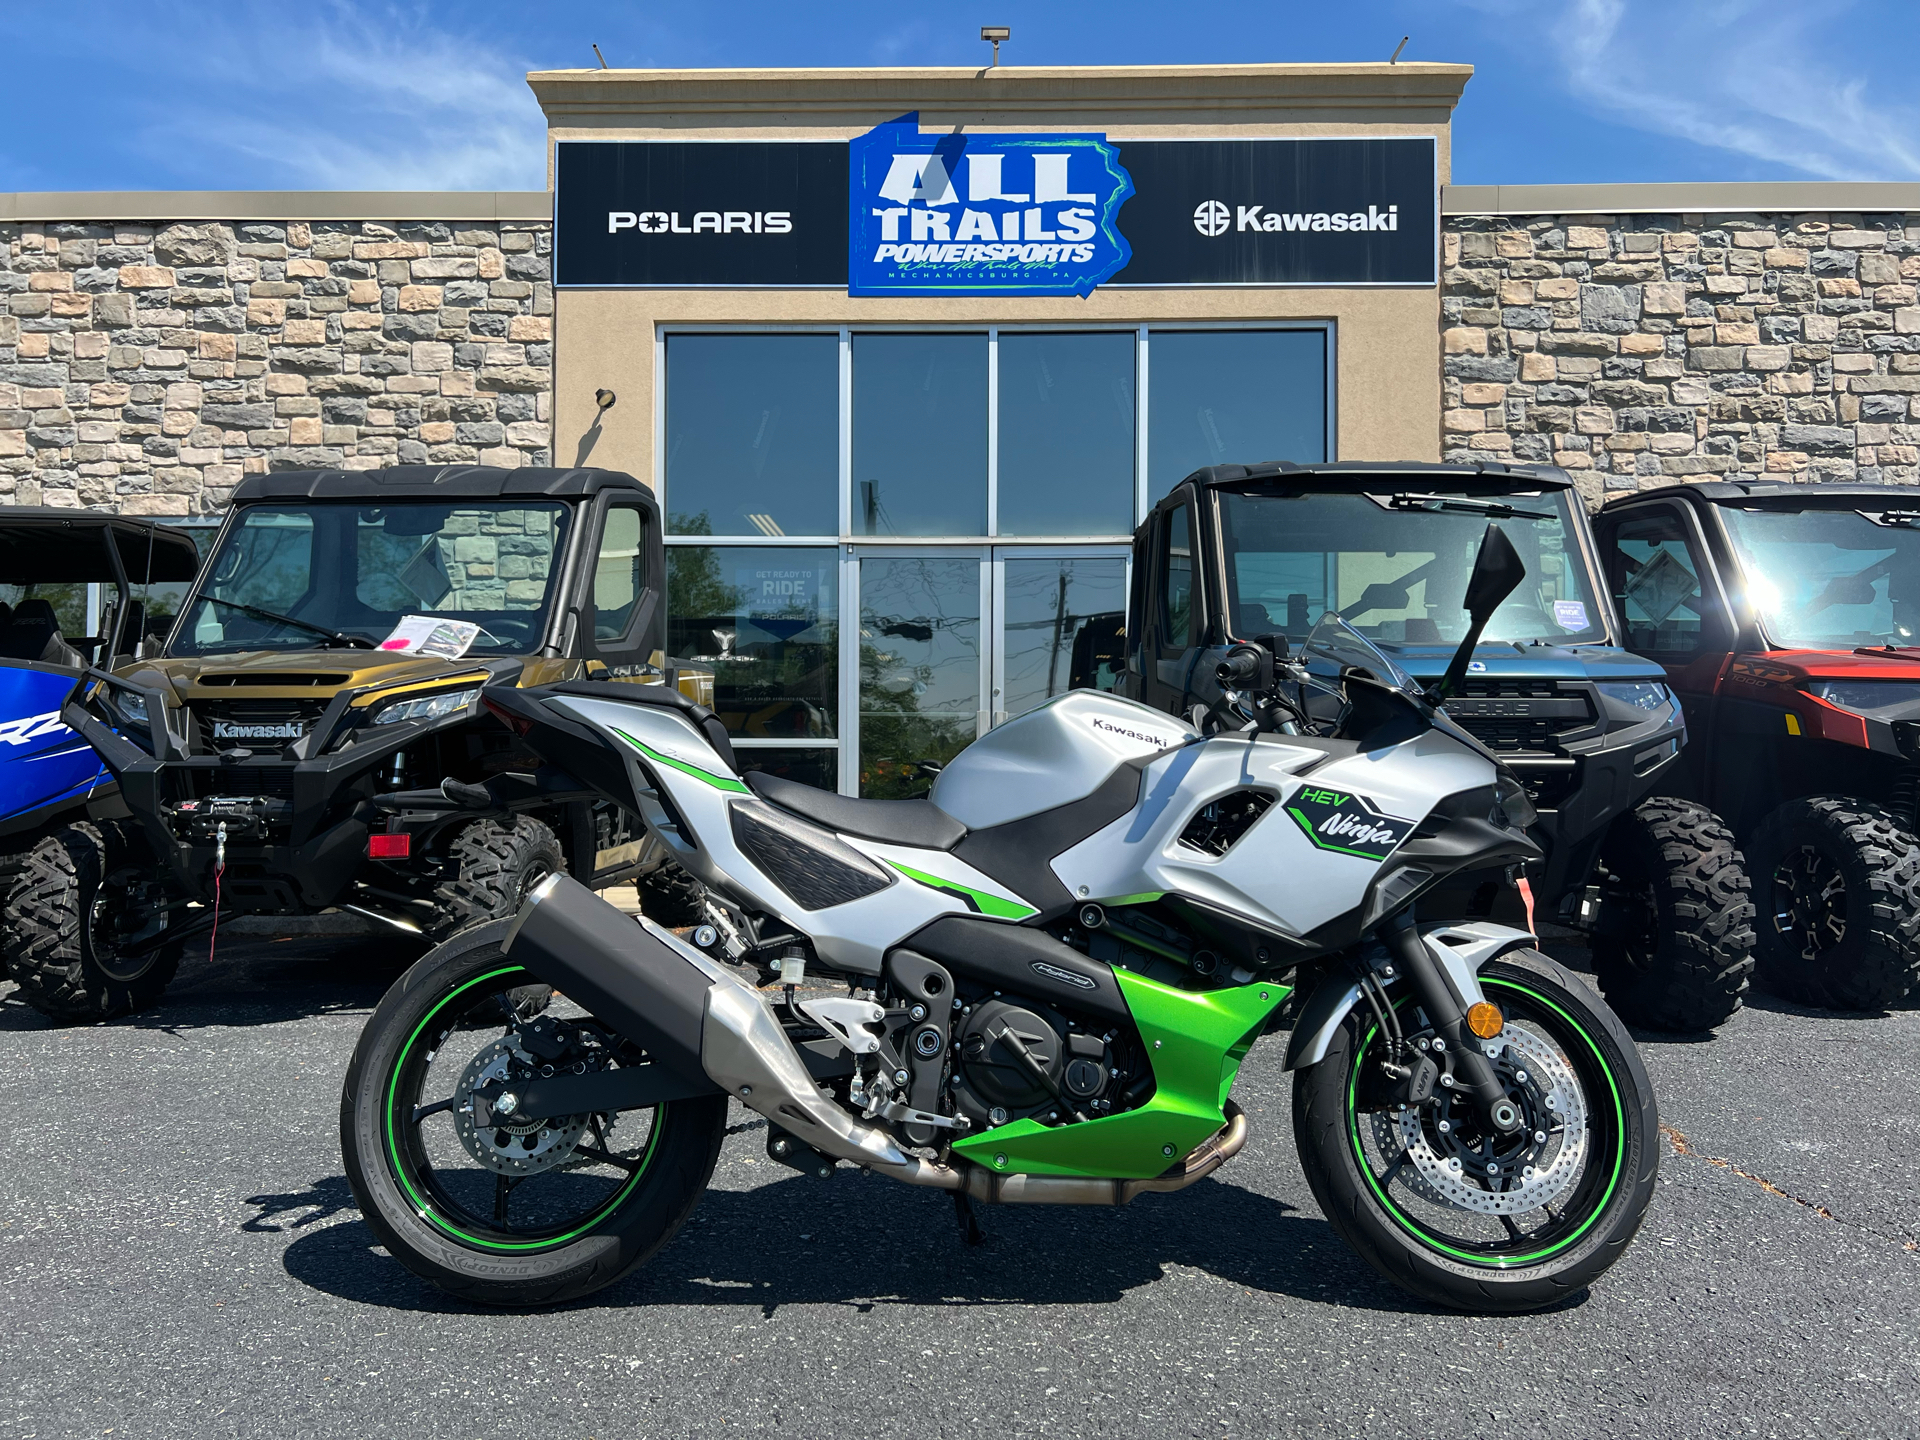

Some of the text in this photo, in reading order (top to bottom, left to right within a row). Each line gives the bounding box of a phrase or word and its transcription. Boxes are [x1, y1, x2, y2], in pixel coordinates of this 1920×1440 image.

[878, 154, 1096, 207] ALL
[608, 211, 793, 233] POLARIS
[872, 207, 1097, 241] TRAILS
[1237, 205, 1398, 232] Kawasaki
[873, 243, 1096, 263] POWERSPORTS
[897, 260, 946, 271] Where
[947, 259, 977, 272] All
[980, 259, 1022, 271] Trails
[762, 580, 805, 597] RIDE
[1734, 661, 1790, 677] XP
[1733, 674, 1768, 687] 1000
[1440, 700, 1531, 716] OLARIS
[214, 722, 303, 738] Kawasaki
[1092, 718, 1168, 748] Kawasaki
[1300, 787, 1350, 807] HEV
[1317, 812, 1397, 846] Ninja
[1511, 957, 1558, 979] DUNLOP
[466, 1261, 530, 1275] DUNLOP
[1457, 1266, 1508, 1278] DUNLOP
